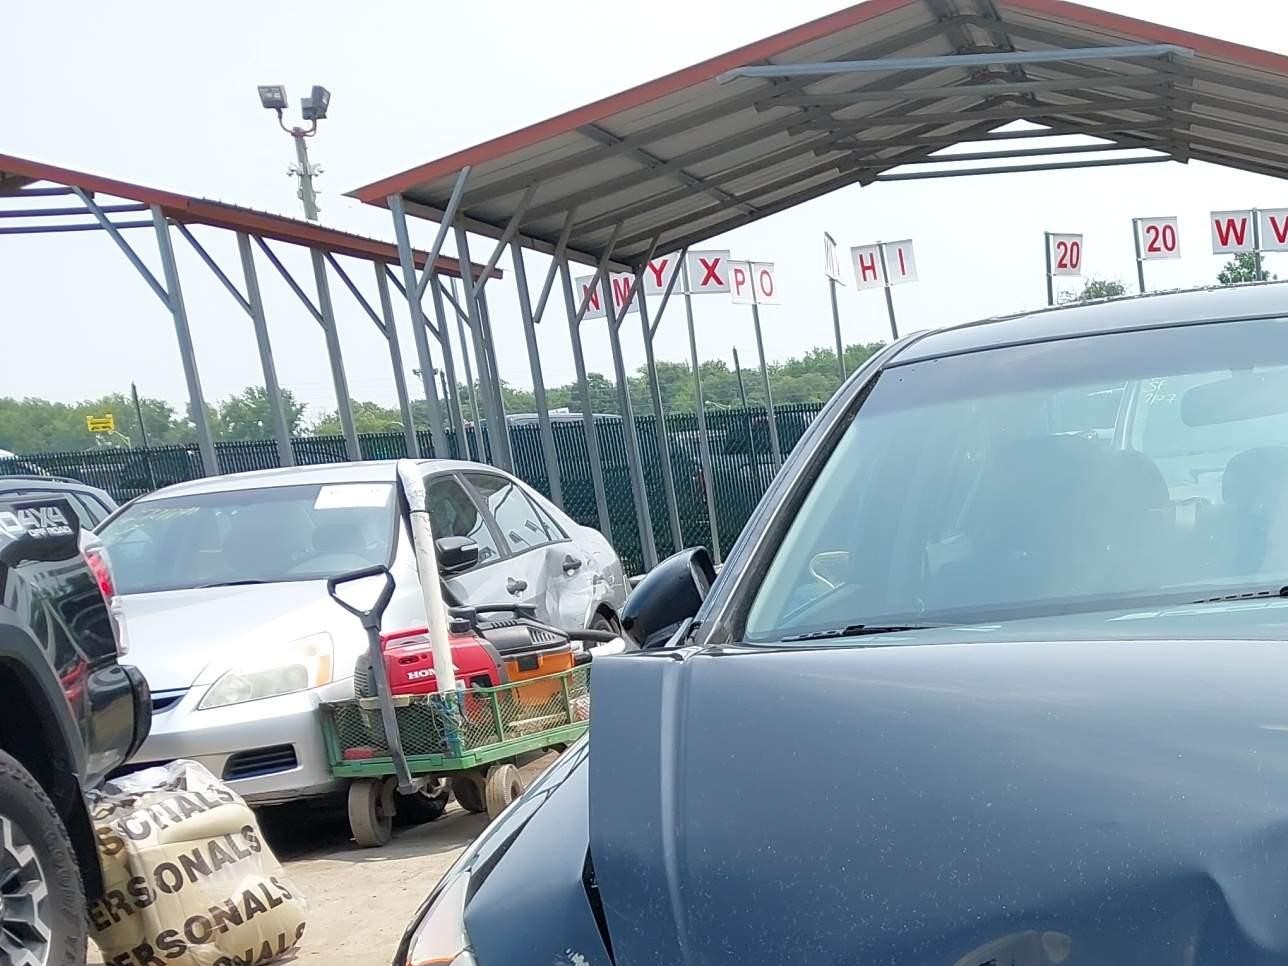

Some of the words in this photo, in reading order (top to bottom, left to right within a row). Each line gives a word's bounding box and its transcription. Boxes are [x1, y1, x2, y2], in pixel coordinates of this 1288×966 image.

[1145, 224, 1176, 252] 20
[1214, 218, 1247, 247] W
[859, 252, 877, 282] H
[1056, 241, 1080, 269] 20
[649, 259, 669, 287] Y
[700, 258, 724, 286] X
[734, 268, 745, 296] P
[760, 269, 773, 297] O
